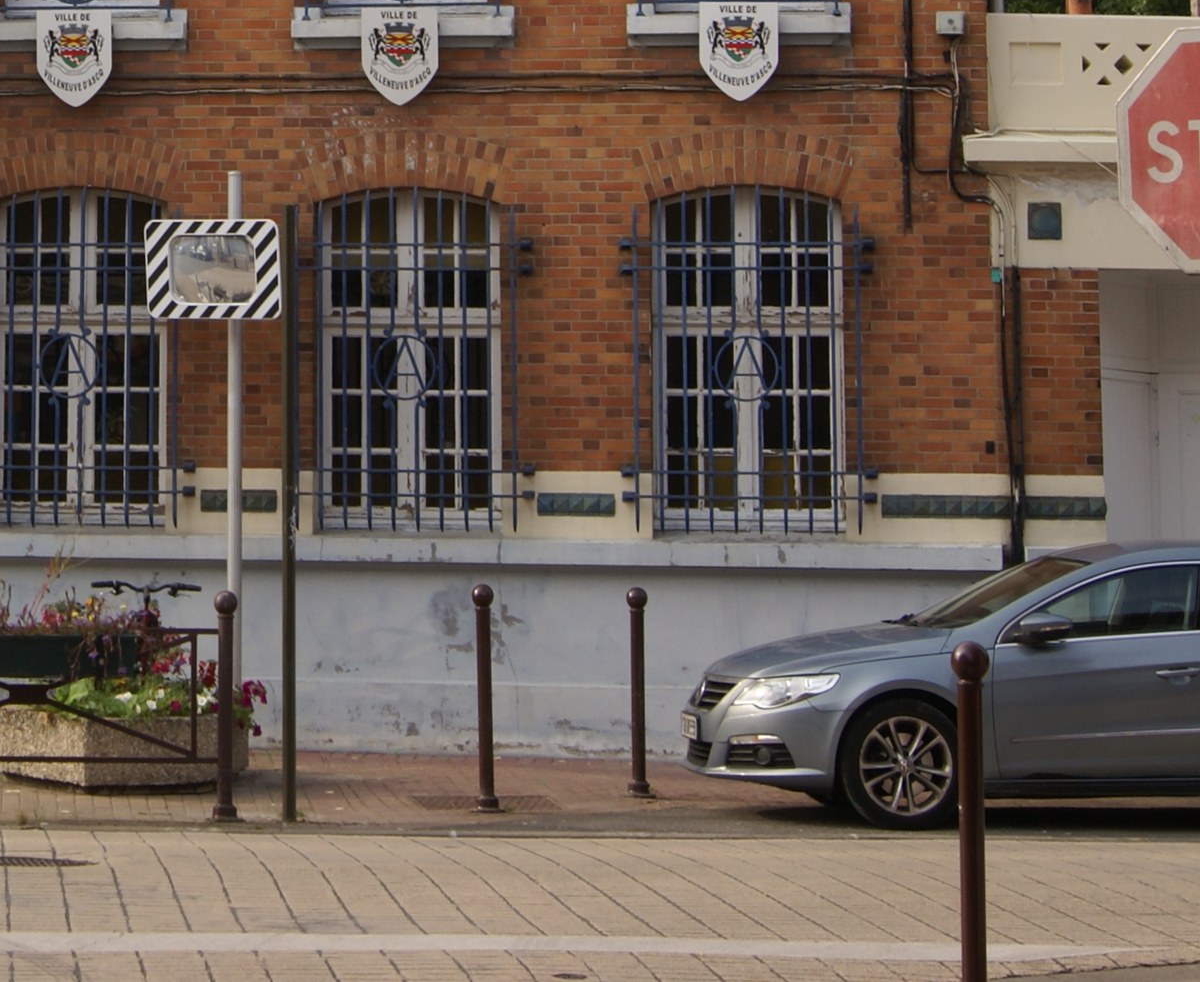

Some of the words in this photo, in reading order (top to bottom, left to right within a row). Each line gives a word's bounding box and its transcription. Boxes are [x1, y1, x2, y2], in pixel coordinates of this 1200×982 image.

[380, 11, 404, 19] VILLE
[407, 11, 417, 19] DE
[719, 5, 743, 13] VILLE
[746, 5, 757, 13] DE
[55, 13, 77, 21] VILLE
[80, 13, 90, 21] DE
[44, 69, 82, 92] VILLENEUVE
[369, 66, 408, 90] VILLENEUVE
[709, 63, 750, 87] VILLENEUVE
